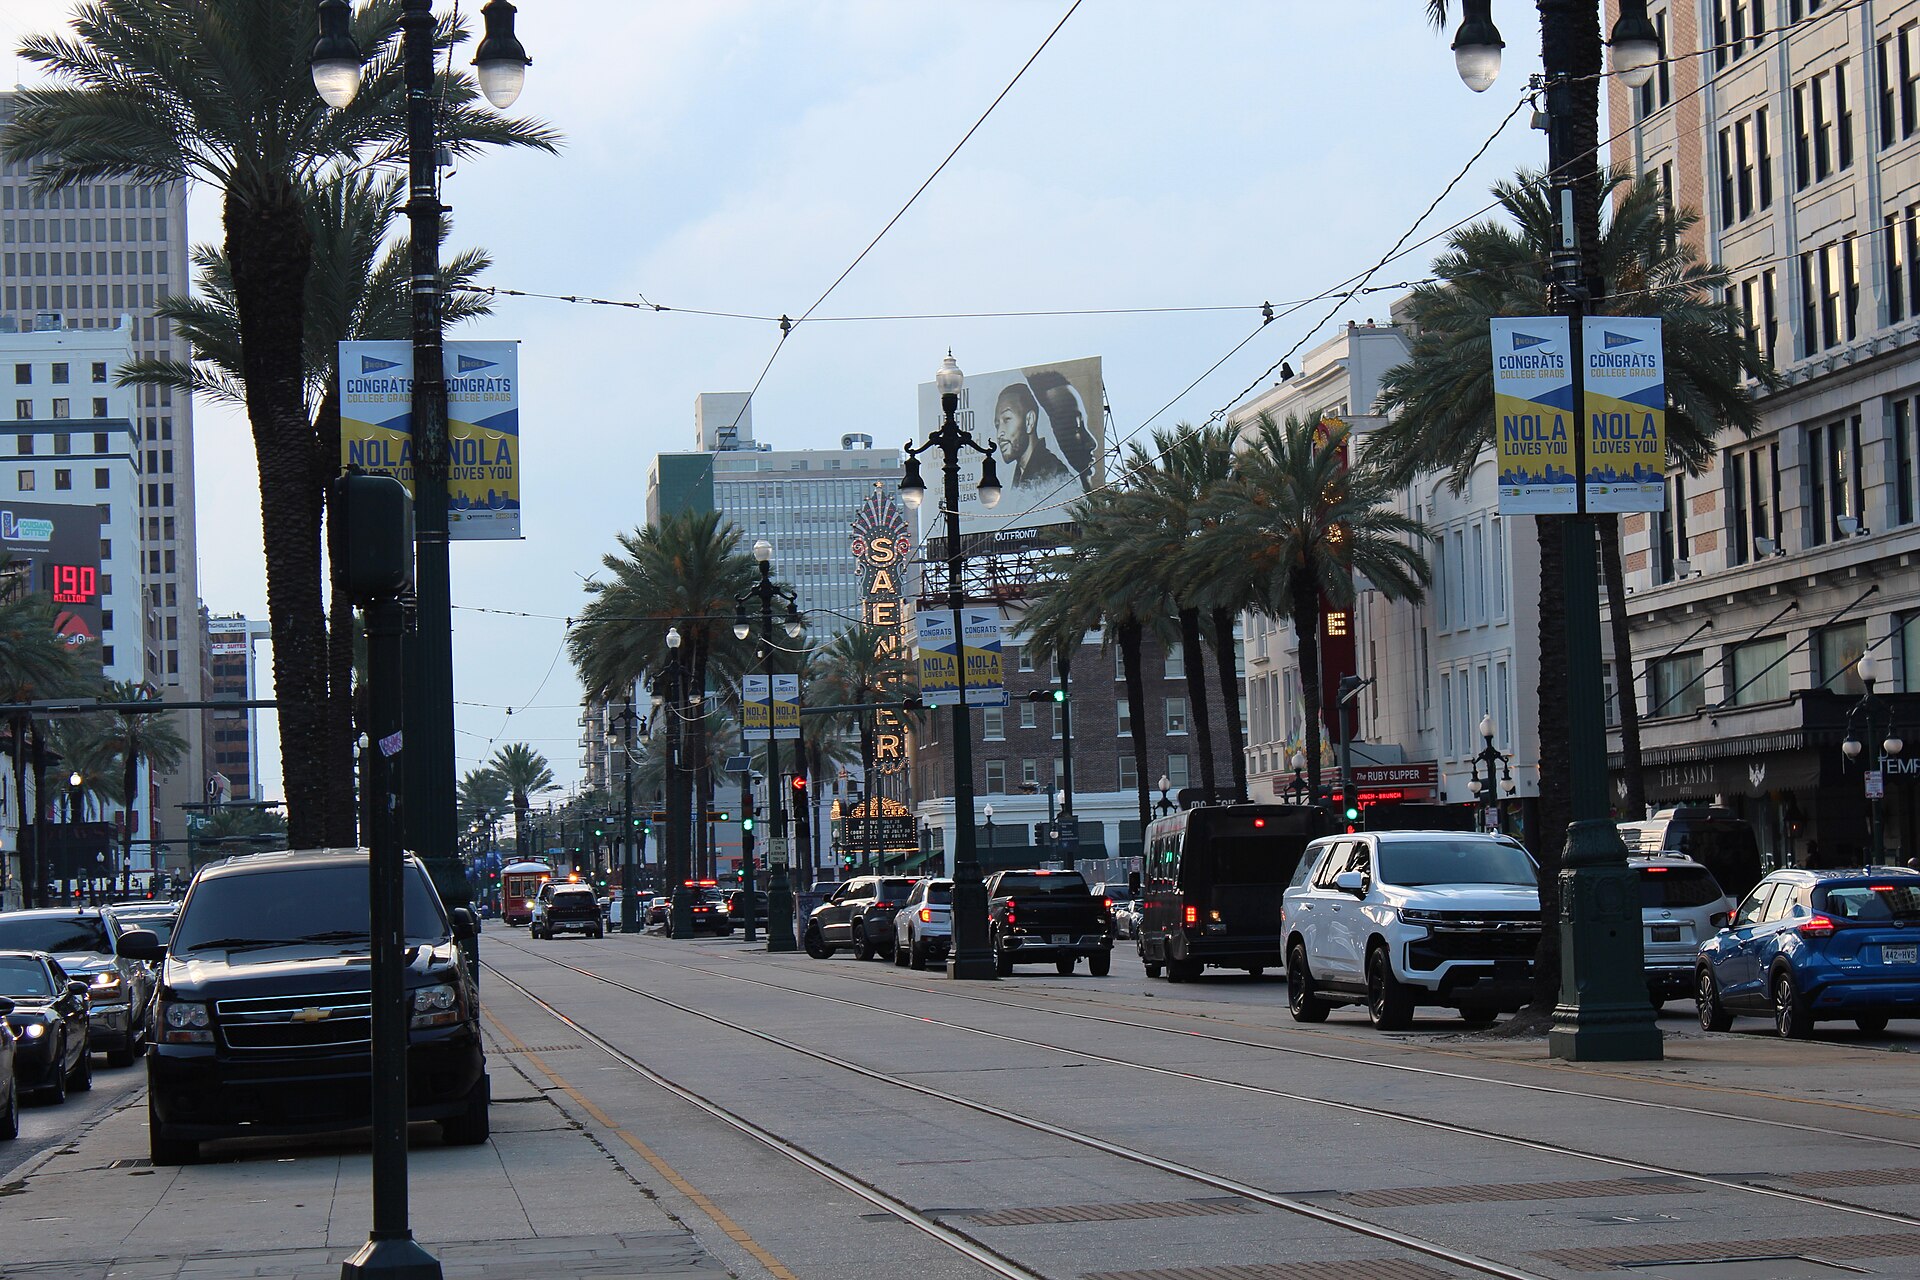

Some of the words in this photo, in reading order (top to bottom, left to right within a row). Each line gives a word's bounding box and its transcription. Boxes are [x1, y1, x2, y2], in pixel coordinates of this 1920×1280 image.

[1500, 354, 1564, 370] CONGRATS
[1590, 354, 1655, 368] CONGRATS
[1500, 369, 1536, 379] COLLEGE
[1538, 368, 1565, 379] GRADS
[1591, 368, 1626, 378] COLLEGE
[1629, 367, 1657, 378] GRADS
[347, 378, 414, 394] CONGRATS
[446, 378, 511, 393] CONGRATS
[347, 394, 385, 403] COLLEGE
[483, 392, 511, 402] GRADS
[1503, 414, 1567, 441] NOLA
[1592, 413, 1657, 440] NOLA
[349, 439, 414, 467] NOLA
[448, 438, 512, 466] NOLA
[1504, 442, 1541, 456] LOVES
[1545, 441, 1568, 455] YOU
[1592, 441, 1630, 454] LOVES
[1634, 440, 1658, 453] YOU
[489, 466, 512, 480] YOU
[21, 529, 51, 537] LOTTERY
[53, 565, 96, 595] 190
[53, 594, 87, 603] MILLION
[920, 628, 952, 637] CONGRATS
[964, 625, 997, 635] CONGRATS
[923, 657, 955, 671] NOLA
[967, 654, 998, 669] NOLA
[924, 670, 943, 679] LOVES
[945, 669, 956, 677] YOU
[968, 668, 986, 676] LOVES
[987, 667, 999, 675] YOU
[746, 706, 768, 716] NOLA
[775, 706, 797, 715] NOLA
[1356, 772, 1367, 780] The
[1367, 770, 1388, 781] RUBY
[1389, 769, 1420, 780] SLIPPER
[1659, 767, 1679, 788] THE
[1683, 764, 1714, 785] SAINT
